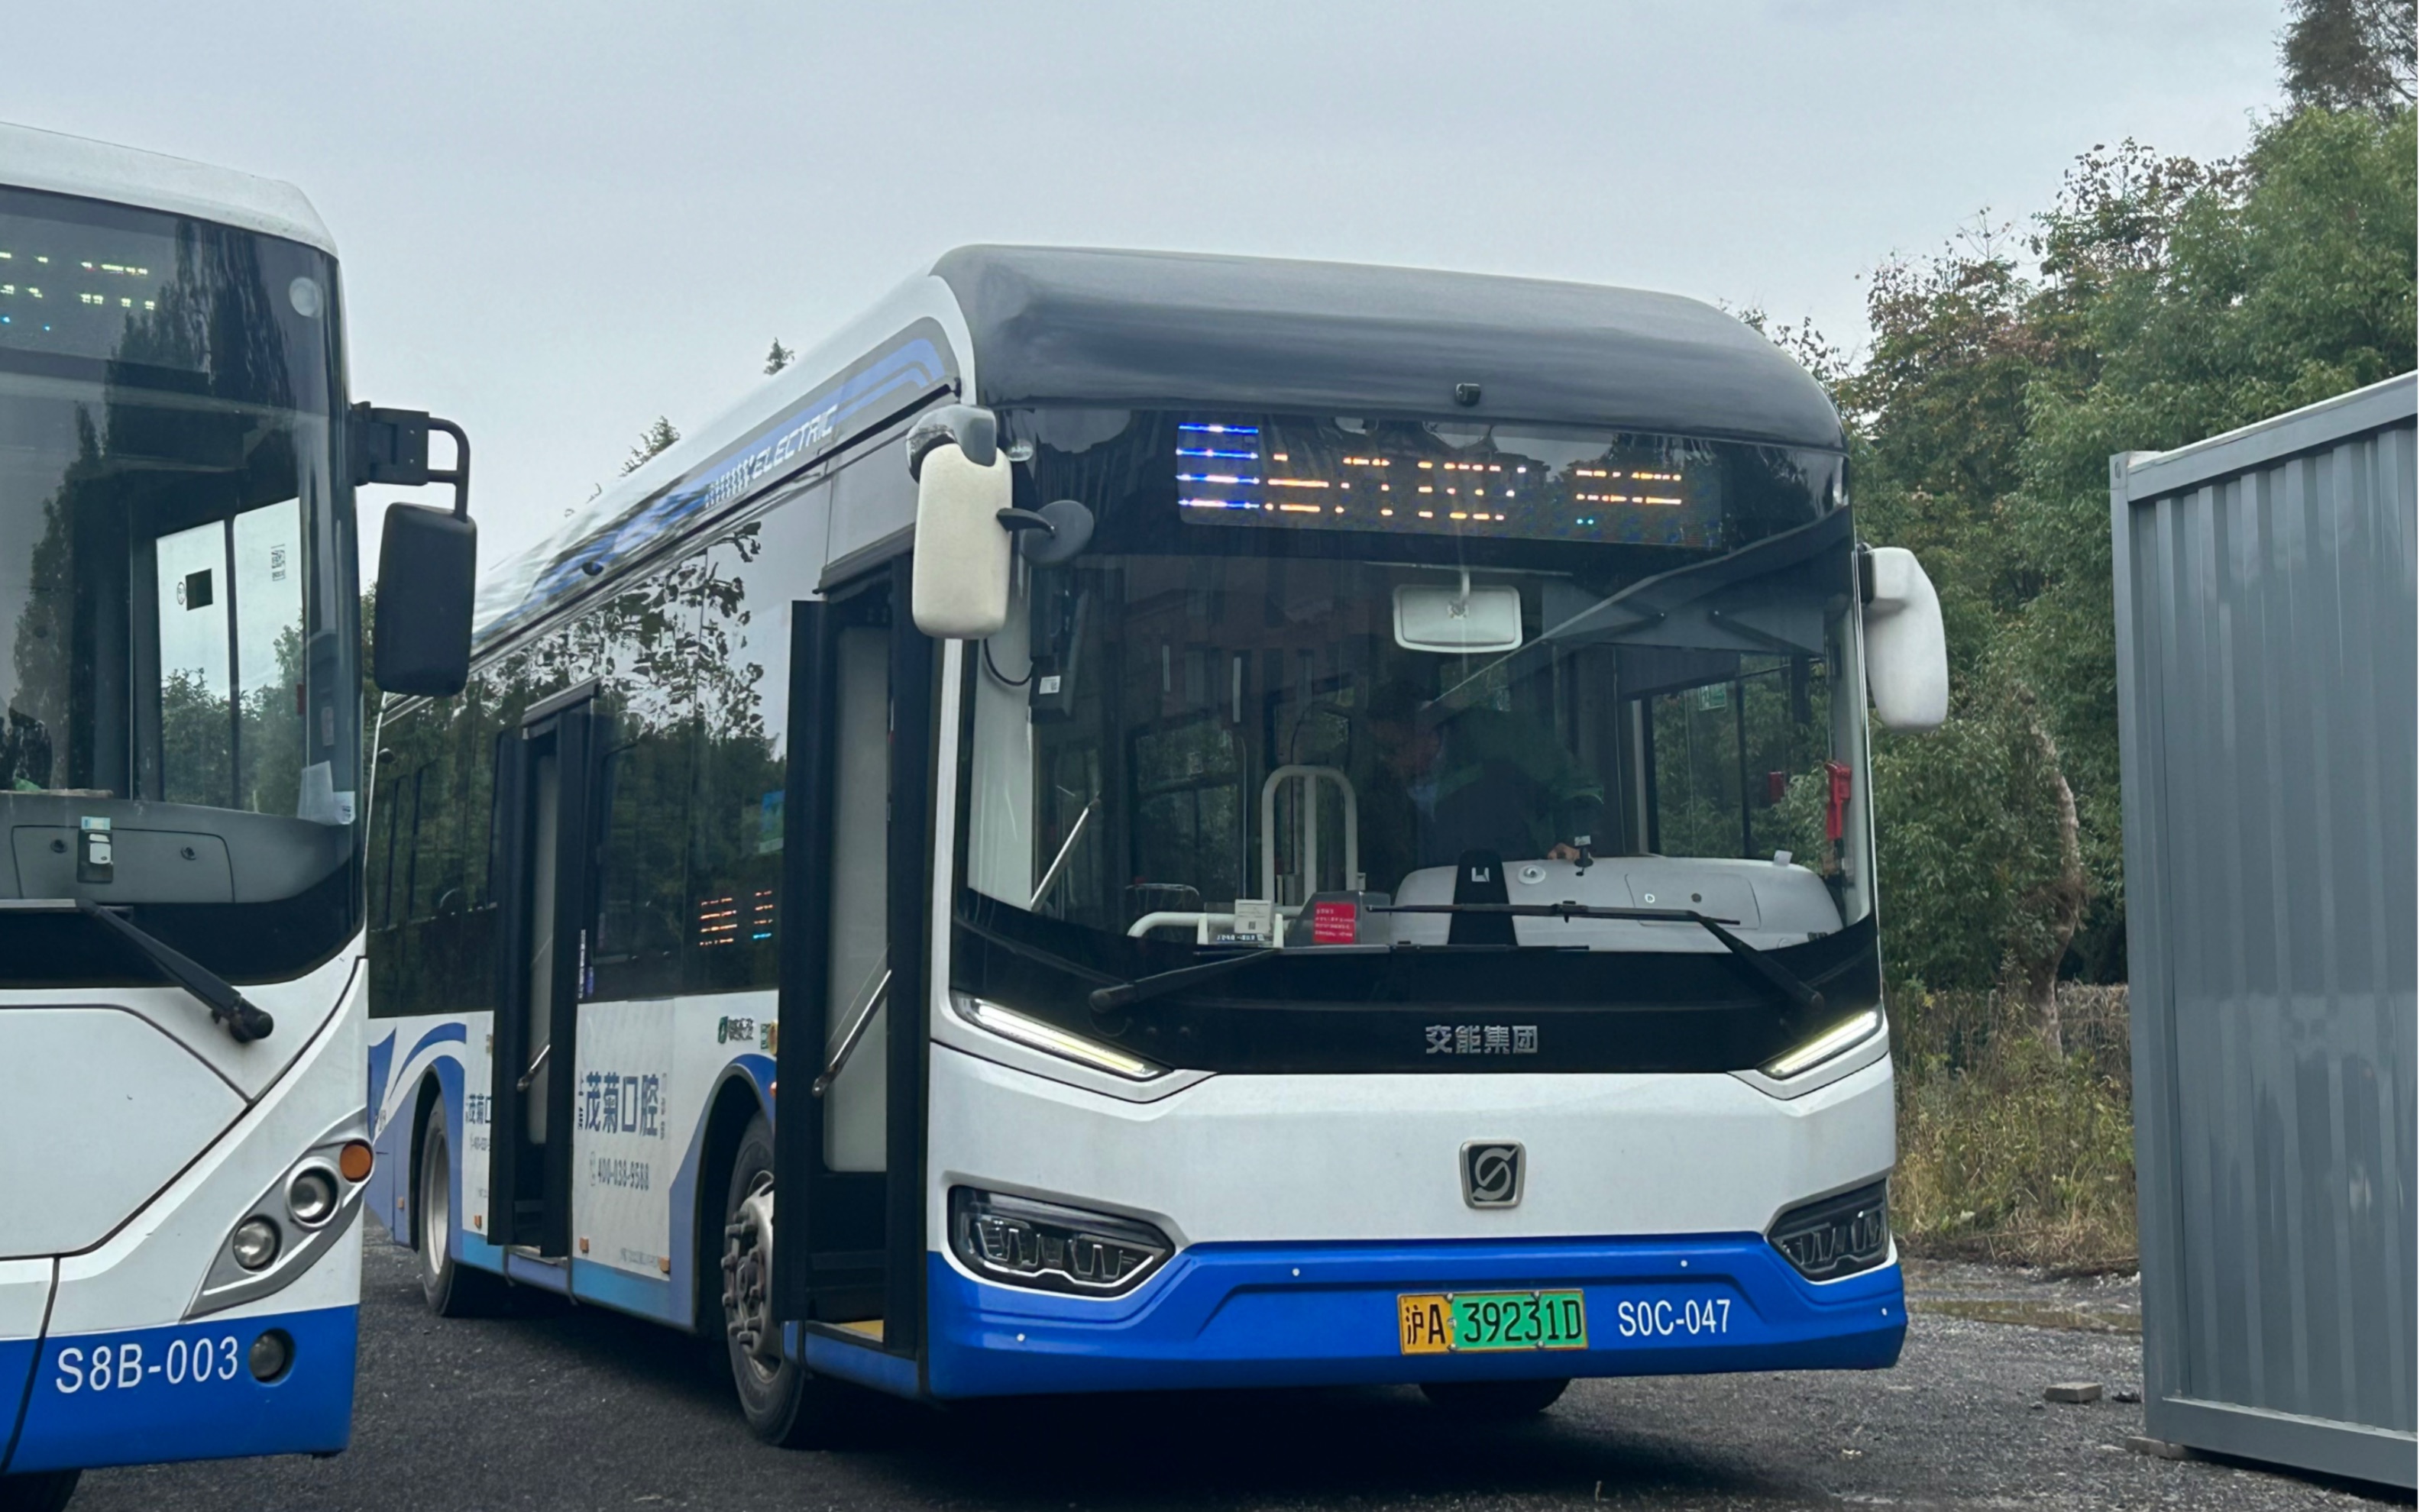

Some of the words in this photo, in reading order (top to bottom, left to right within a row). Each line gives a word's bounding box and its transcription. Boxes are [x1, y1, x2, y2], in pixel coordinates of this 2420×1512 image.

[752, 403, 839, 480] ELECTRIC
[1425, 1025, 1538, 1054] 交能集团
[585, 1071, 659, 1136] 茂菊口腔
[56, 1336, 238, 1394] S8B-003
